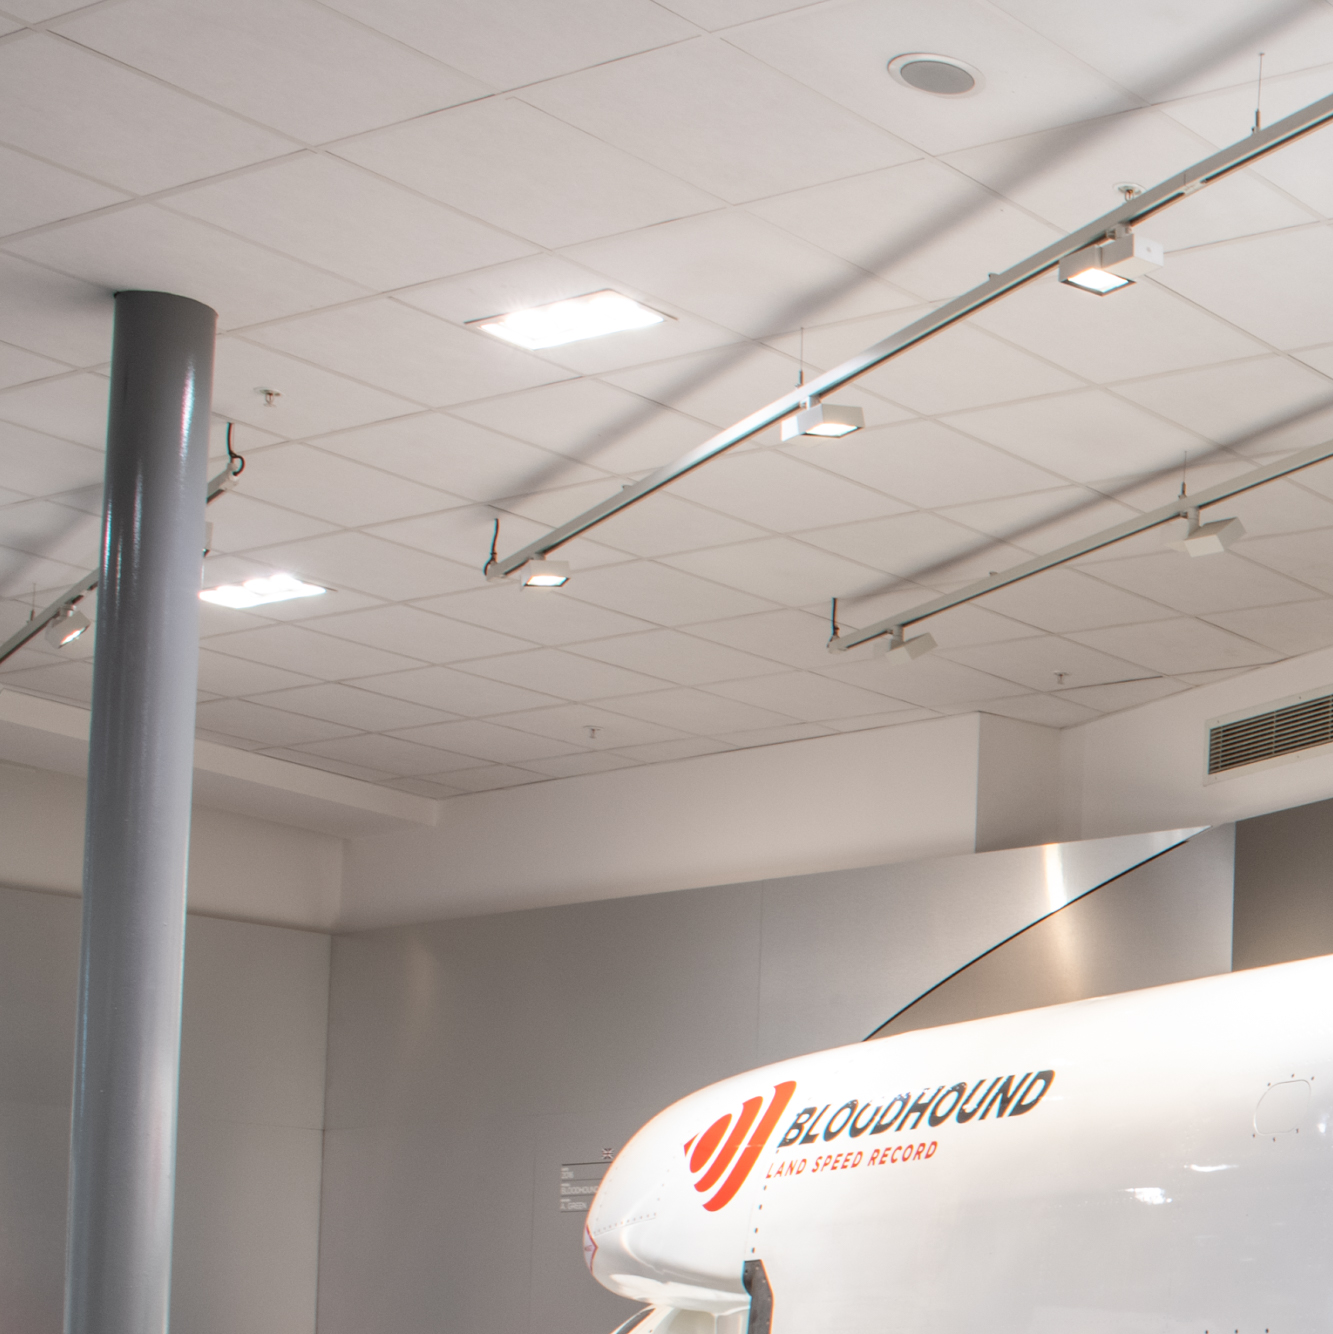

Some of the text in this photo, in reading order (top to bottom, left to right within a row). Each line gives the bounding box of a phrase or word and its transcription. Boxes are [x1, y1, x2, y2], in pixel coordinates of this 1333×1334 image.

[776, 1069, 1056, 1148] BLOODHOUND
[765, 1141, 938, 1179] LAND SPEED RECORD
